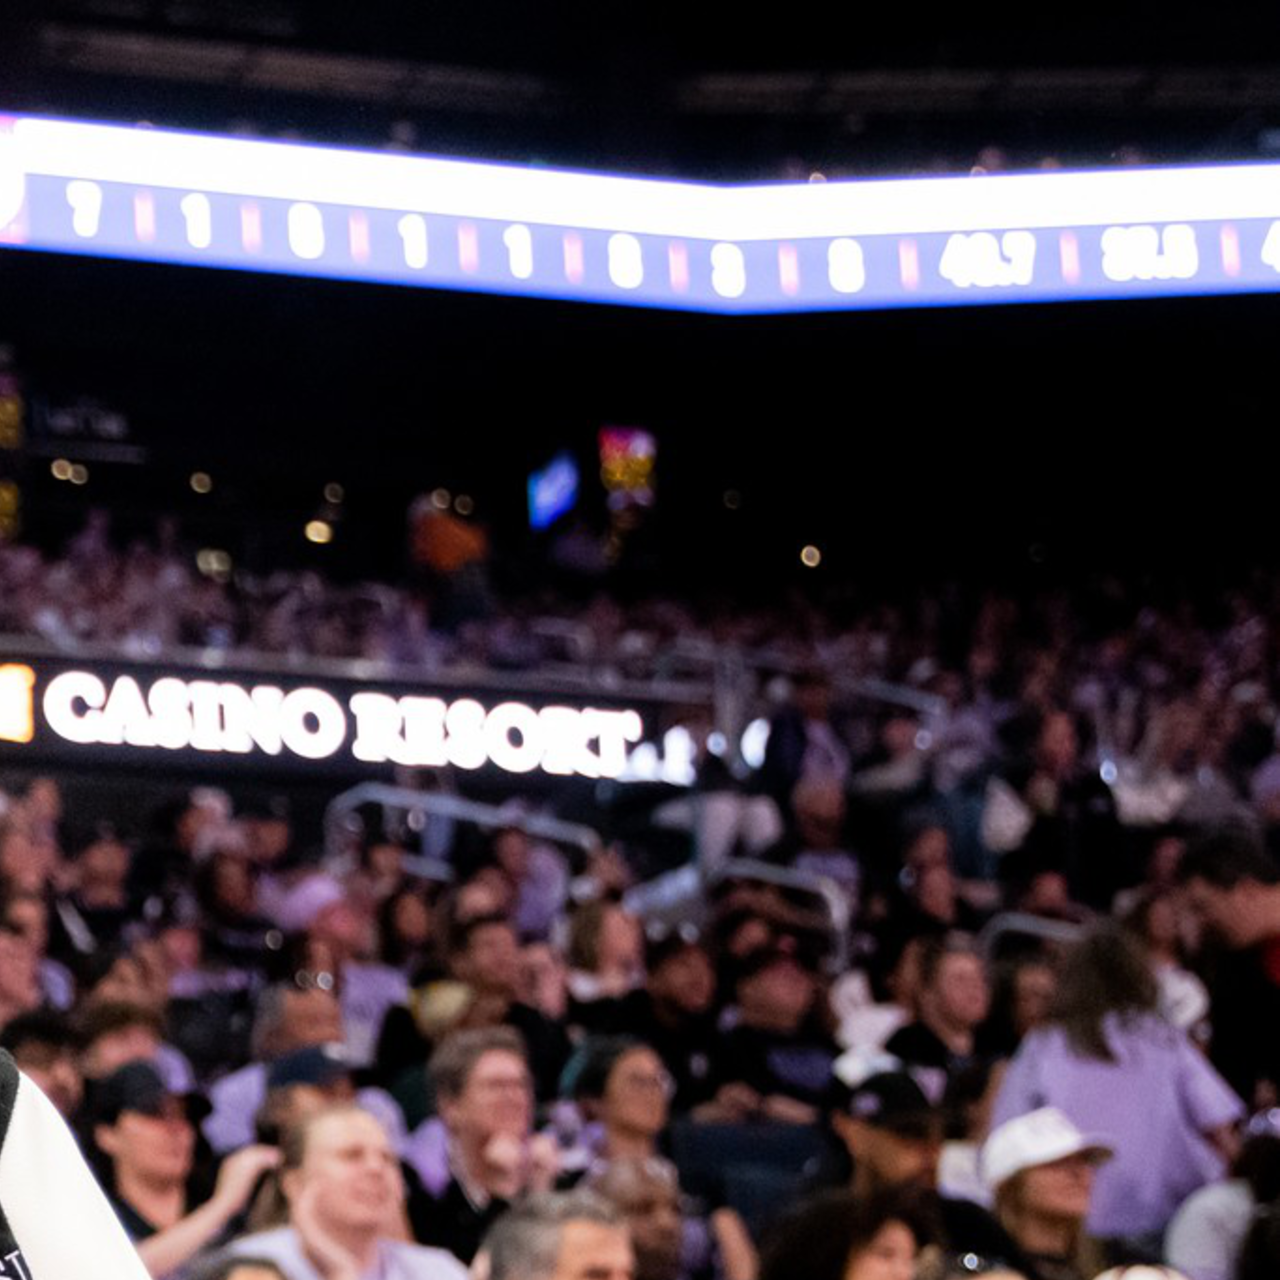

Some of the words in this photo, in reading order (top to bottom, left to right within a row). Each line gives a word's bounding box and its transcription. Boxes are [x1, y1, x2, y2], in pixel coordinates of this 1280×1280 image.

[182, 193, 210, 247] 1
[399, 214, 426, 268] 1
[504, 225, 531, 277] 1
[42, 670, 347, 759] CASINO
[349, 691, 642, 780] RESORT
